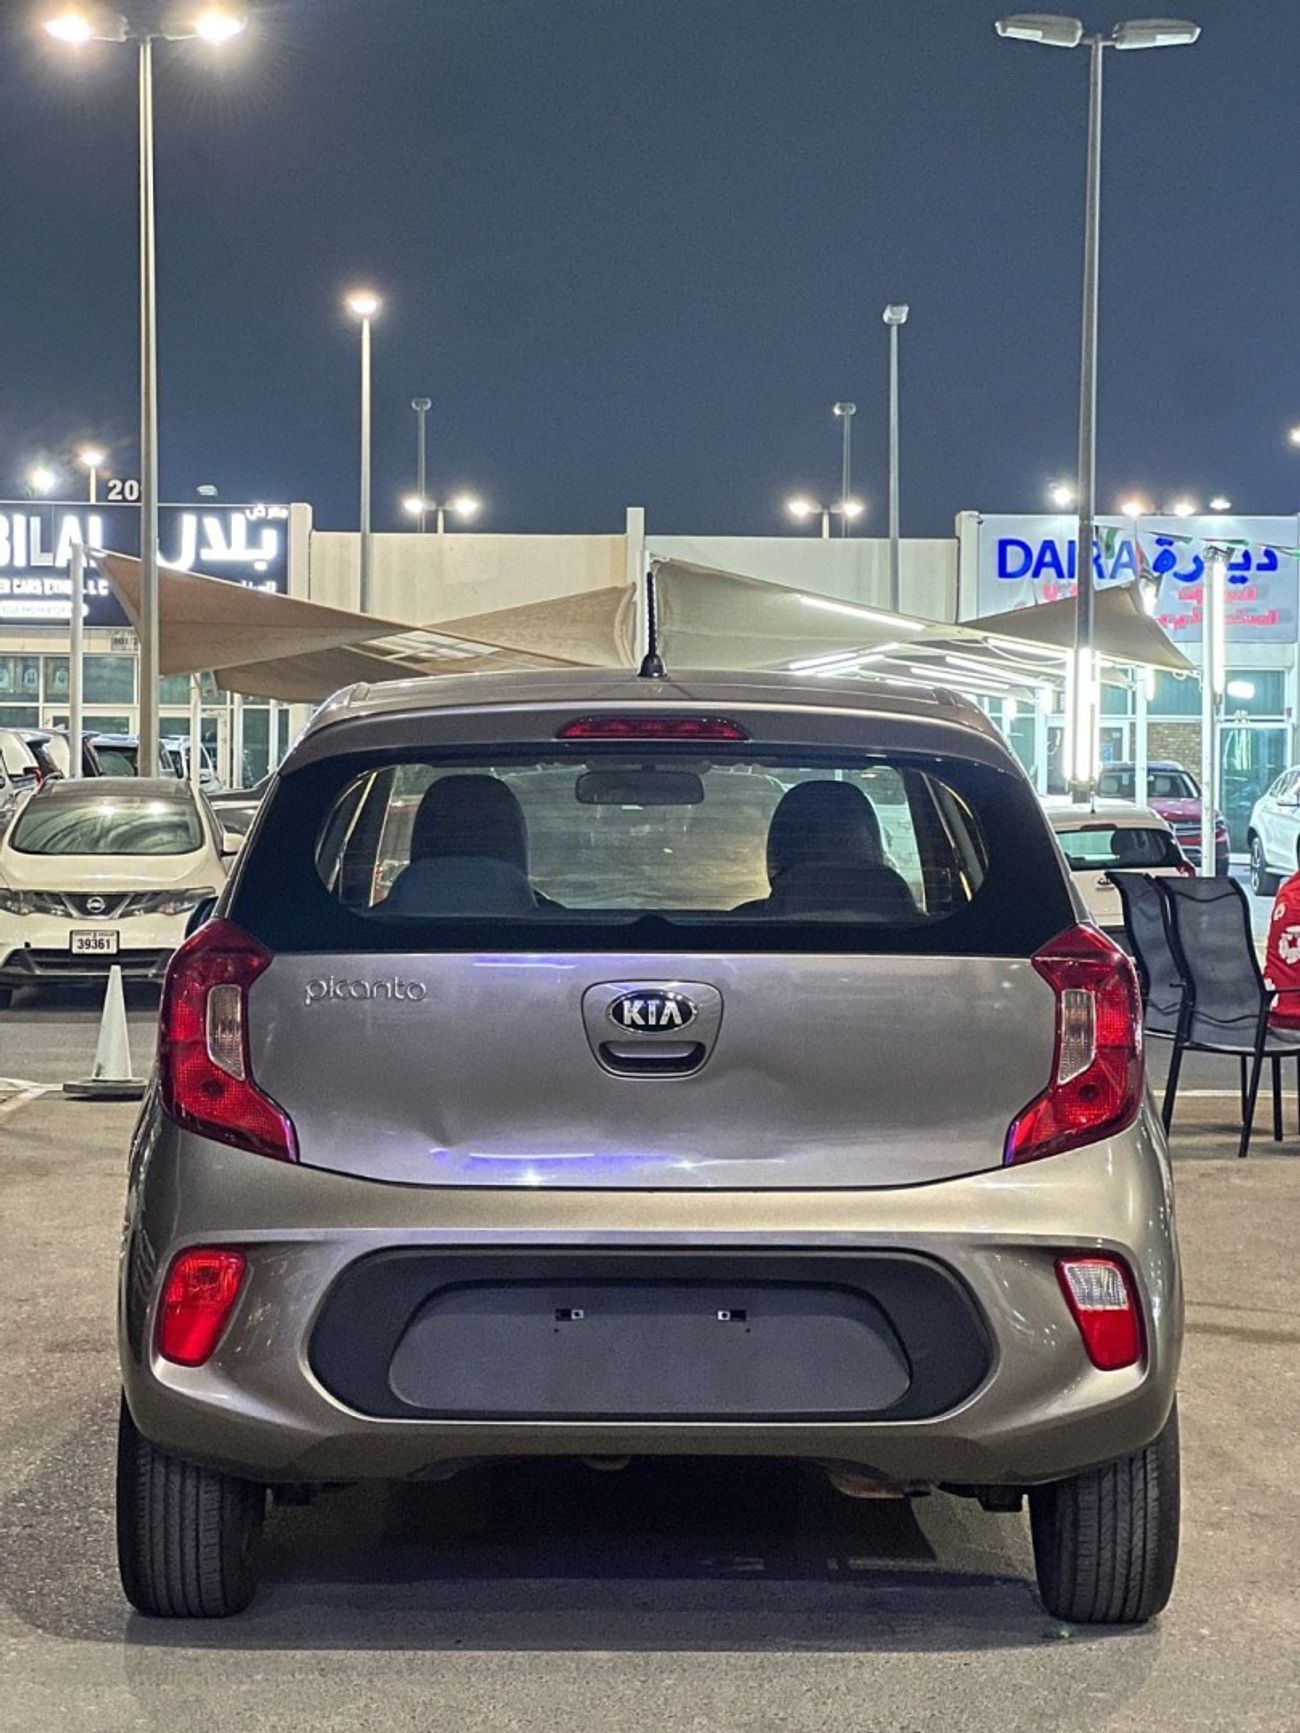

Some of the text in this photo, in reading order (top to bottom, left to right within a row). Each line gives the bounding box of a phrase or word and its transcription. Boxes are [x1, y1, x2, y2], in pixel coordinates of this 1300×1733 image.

[107, 479, 144, 501] 20
[156, 513, 278, 572] بلال
[77, 938, 110, 950] 39361
[304, 975, 427, 1006] picanto
[622, 1000, 683, 1025] KIA
